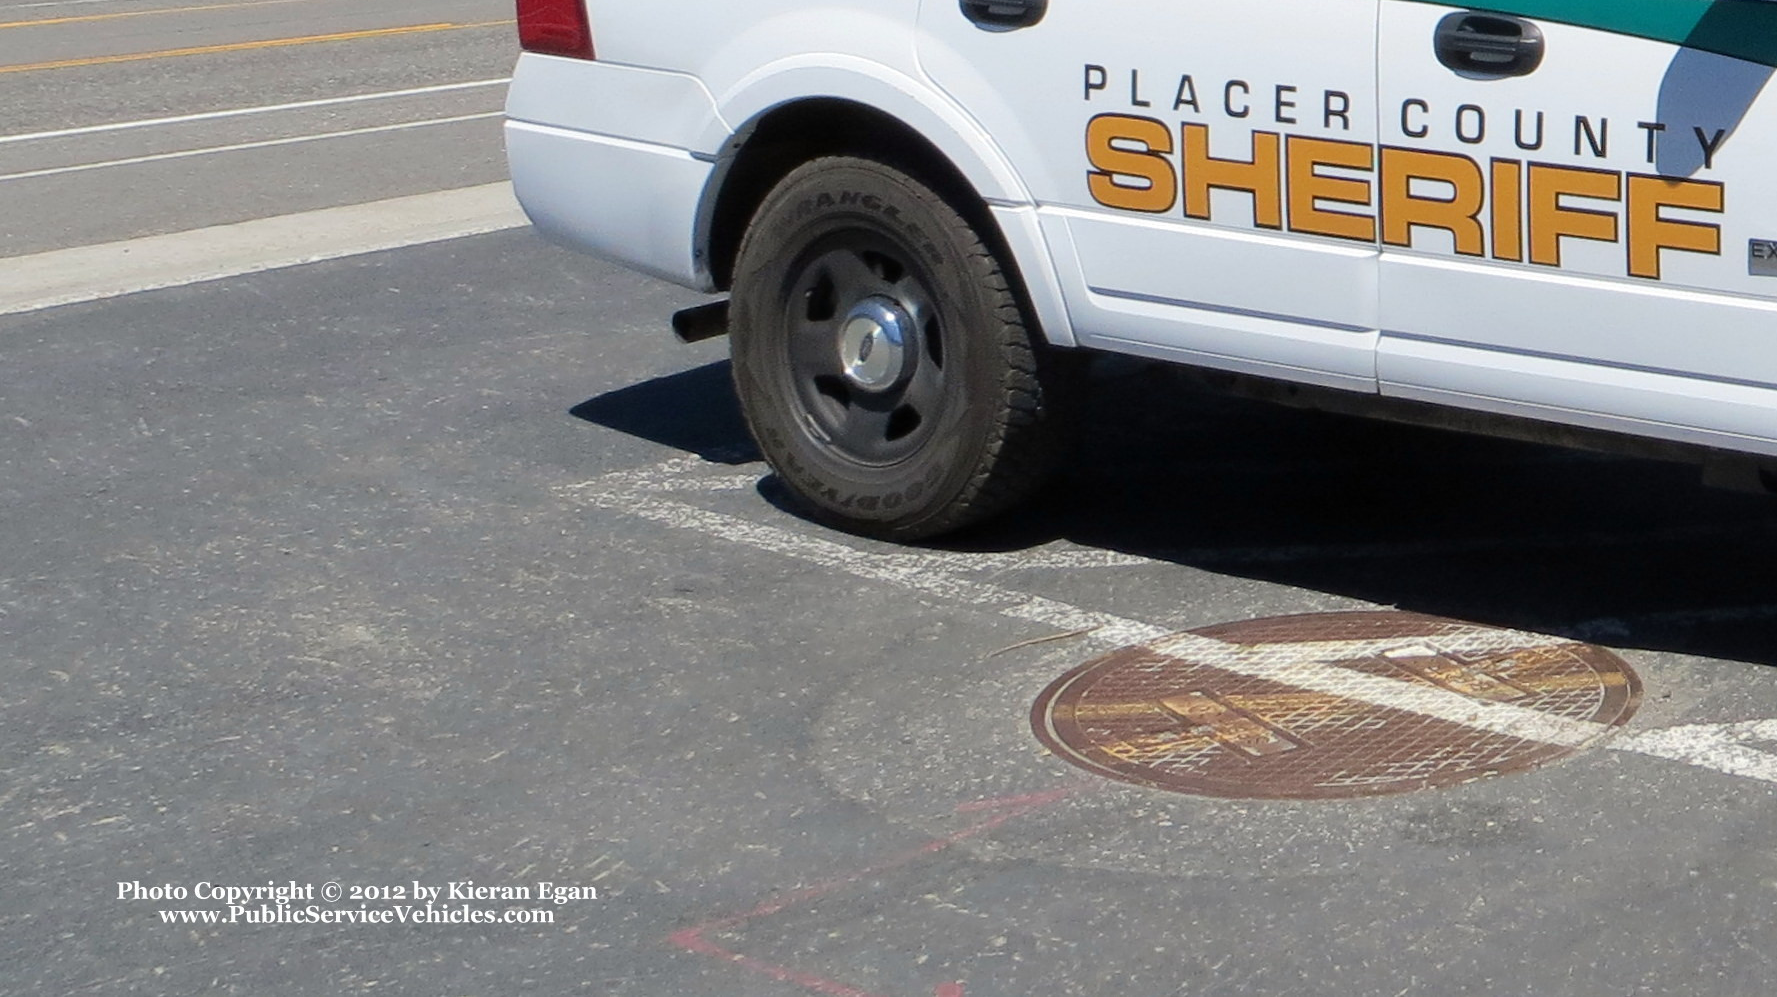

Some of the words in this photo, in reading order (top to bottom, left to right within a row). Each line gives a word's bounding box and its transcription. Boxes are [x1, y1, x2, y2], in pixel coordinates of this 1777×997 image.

[1084, 64, 1351, 131] PLACER
[1400, 98, 1725, 171] COUNTY
[1086, 112, 1725, 280] SHERIFF
